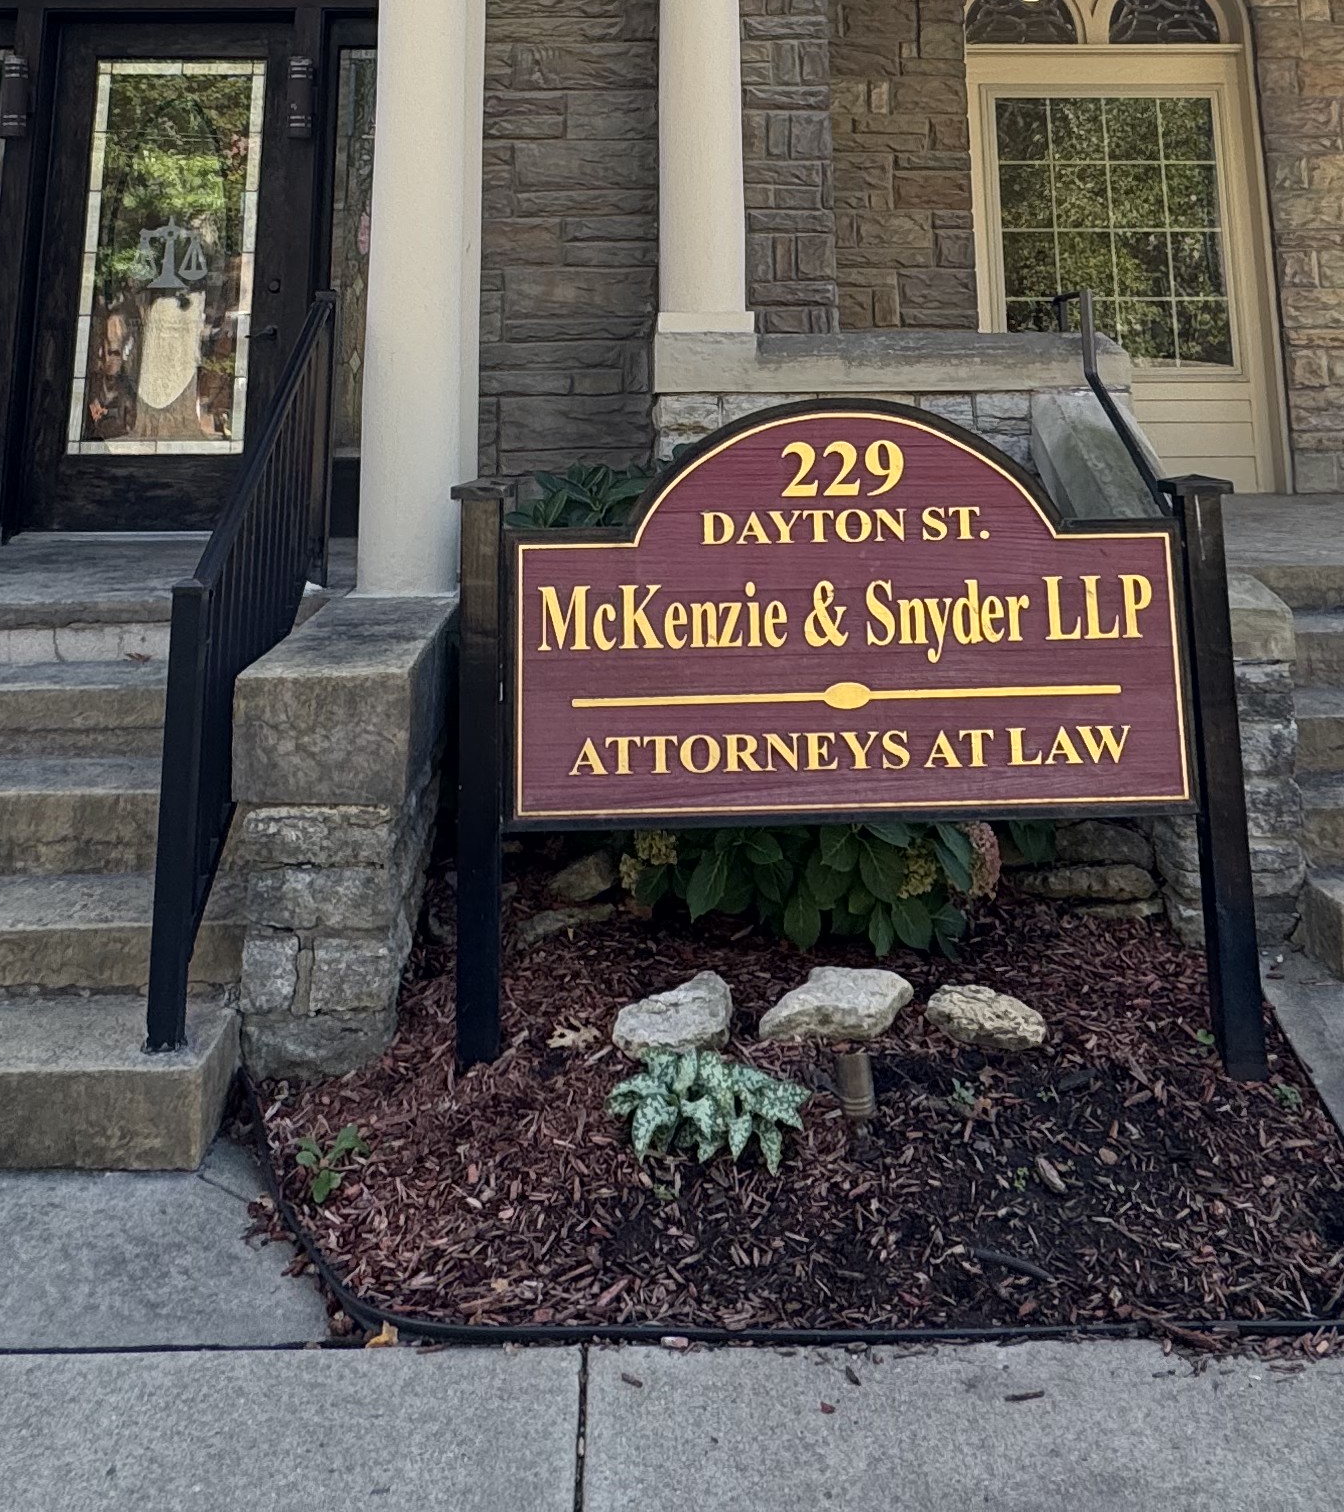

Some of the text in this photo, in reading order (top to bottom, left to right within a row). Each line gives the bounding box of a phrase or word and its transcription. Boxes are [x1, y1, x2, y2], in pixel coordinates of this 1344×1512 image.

[780, 440, 906, 498] 229
[701, 505, 991, 546] DAYTON ST.
[536, 573, 1154, 665] McKenzie & Snyder LLP
[568, 723, 1133, 777] ATTORNEYS AT LAW
